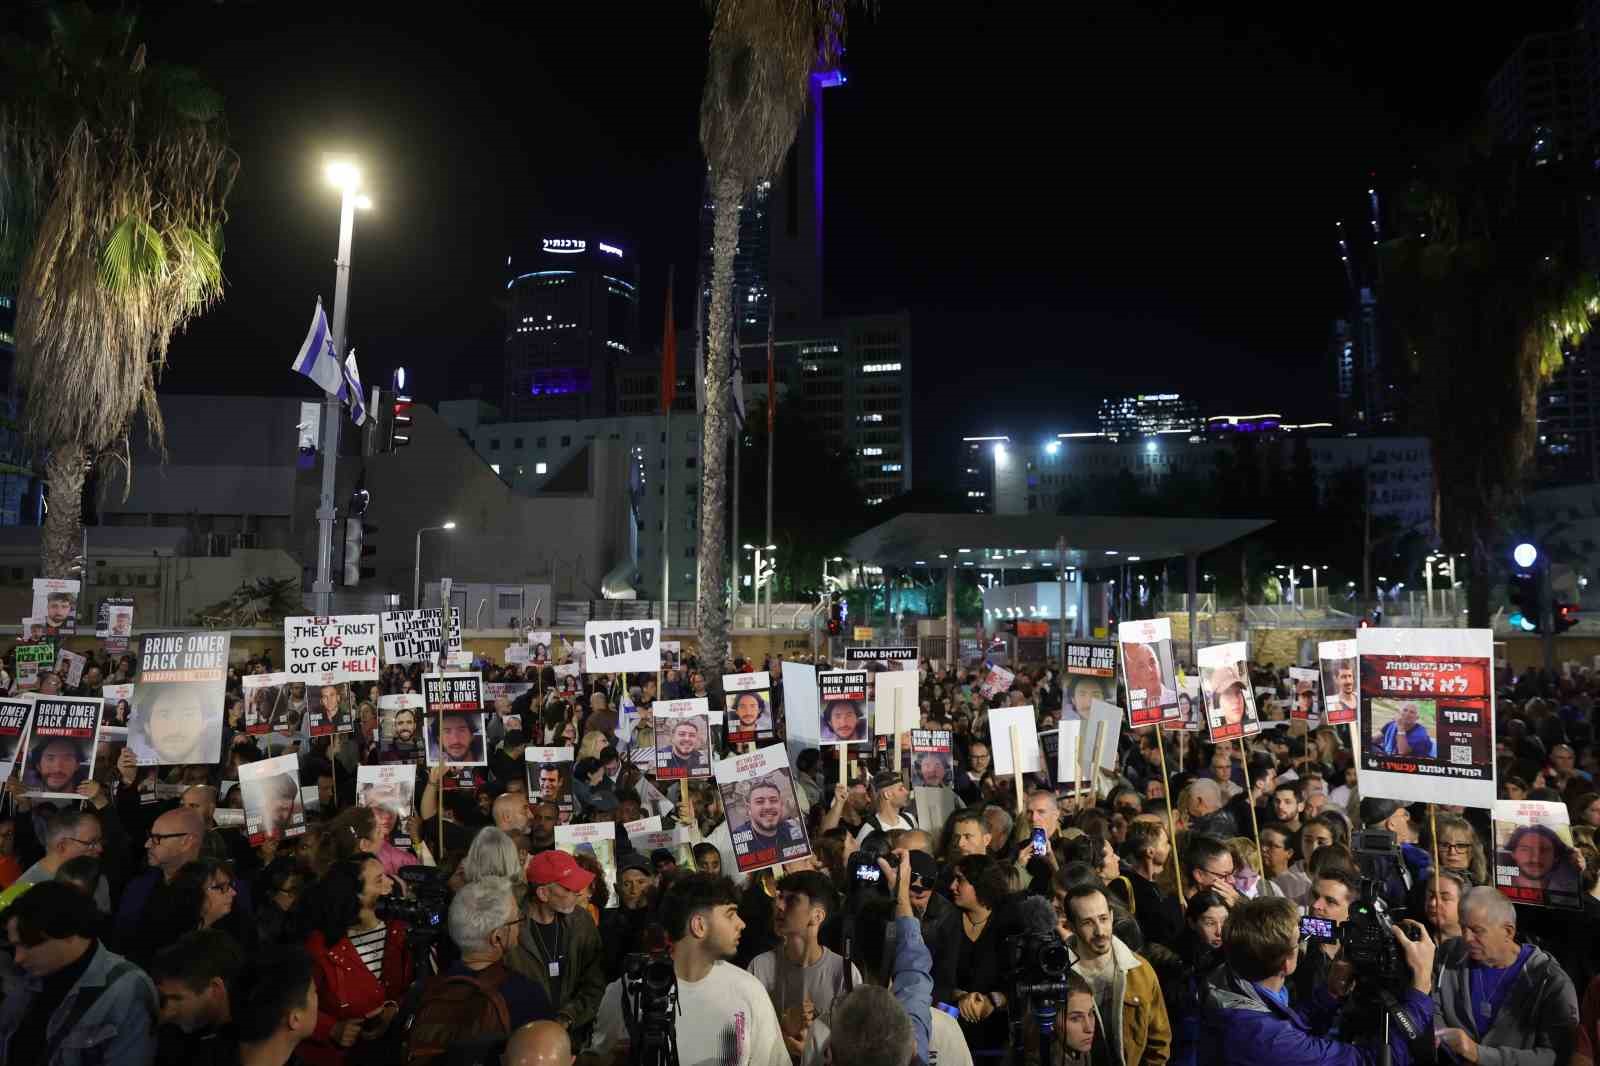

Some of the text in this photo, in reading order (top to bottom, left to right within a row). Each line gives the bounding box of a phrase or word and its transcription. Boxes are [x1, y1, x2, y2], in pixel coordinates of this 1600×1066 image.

[542, 238, 586, 248] מרכנתיל
[293, 623, 376, 637] THEY TRUST
[144, 636, 225, 654] BRING OMER
[323, 636, 343, 649] US
[291, 645, 377, 659] TO GET THEM
[879, 650, 912, 658] SHTIVI
[1067, 645, 1114, 659] BRING OMER
[143, 652, 225, 670] BACK HOME
[290, 656, 377, 674] OUT OF HELL!
[1067, 655, 1114, 669] BACK HOME
[453, 679, 476, 691] OMER
[822, 675, 864, 684] BRING OMER
[1380, 674, 1469, 693] לא איתנו
[453, 691, 477, 702] HOME
[0, 705, 27, 718] OMER
[39, 703, 96, 717] BRING OMER
[1444, 710, 1478, 723] חטוף
[36, 715, 95, 728] BACK HOME
[932, 730, 950, 738] OMER
[912, 737, 950, 746] BACK HOME
[732, 830, 754, 844] BRING
[734, 841, 750, 856] HIM
[1496, 864, 1520, 876] BRING
[1496, 875, 1512, 886] HIM
